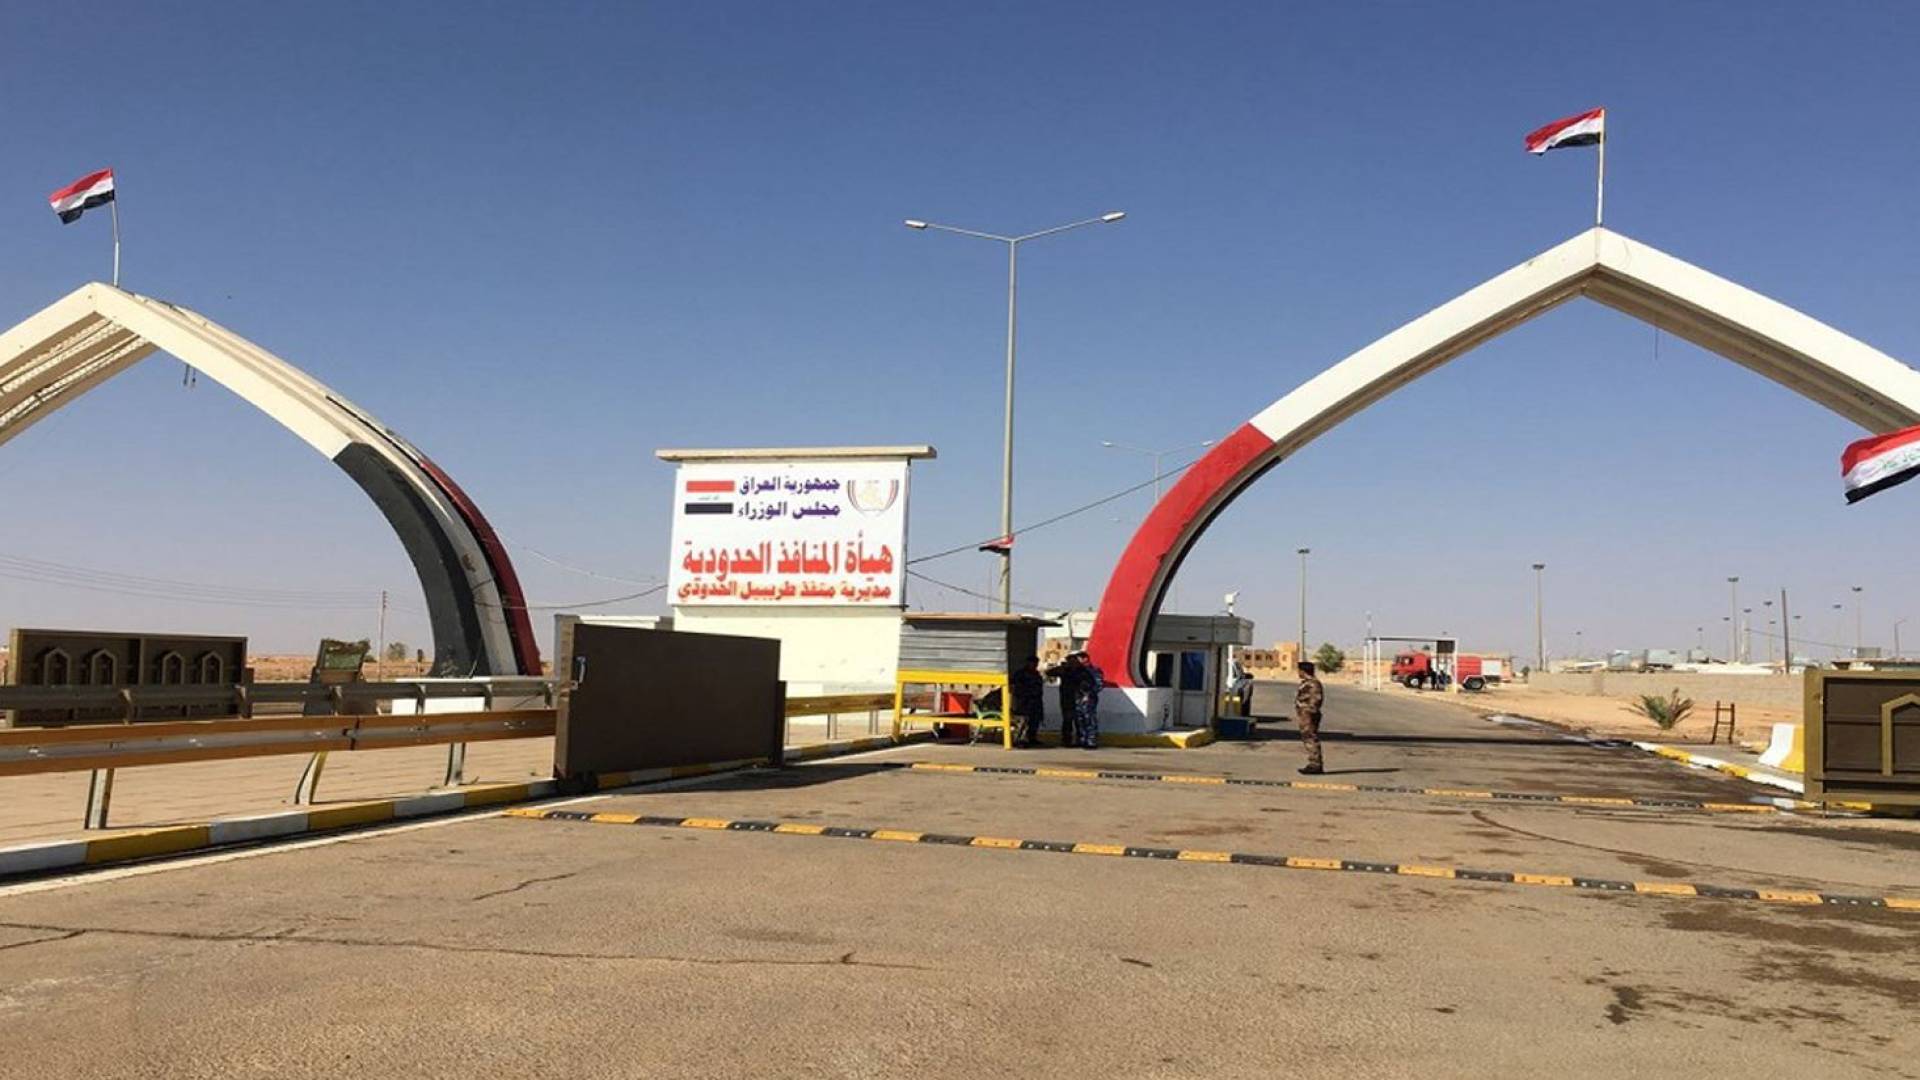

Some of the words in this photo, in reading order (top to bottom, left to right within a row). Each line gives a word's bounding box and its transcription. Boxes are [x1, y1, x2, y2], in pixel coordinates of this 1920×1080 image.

[739, 476, 781, 495] العراق
[784, 475, 840, 495] جمهورية
[738, 501, 787, 520] الوزراء
[793, 501, 840, 519] مجلس
[683, 540, 771, 582] الحدودية
[777, 540, 838, 574] المنافذ
[844, 530, 893, 582] هيأة
[678, 580, 737, 602] الحدودي
[800, 580, 835, 598] منفذ
[840, 581, 891, 602] مديرية
